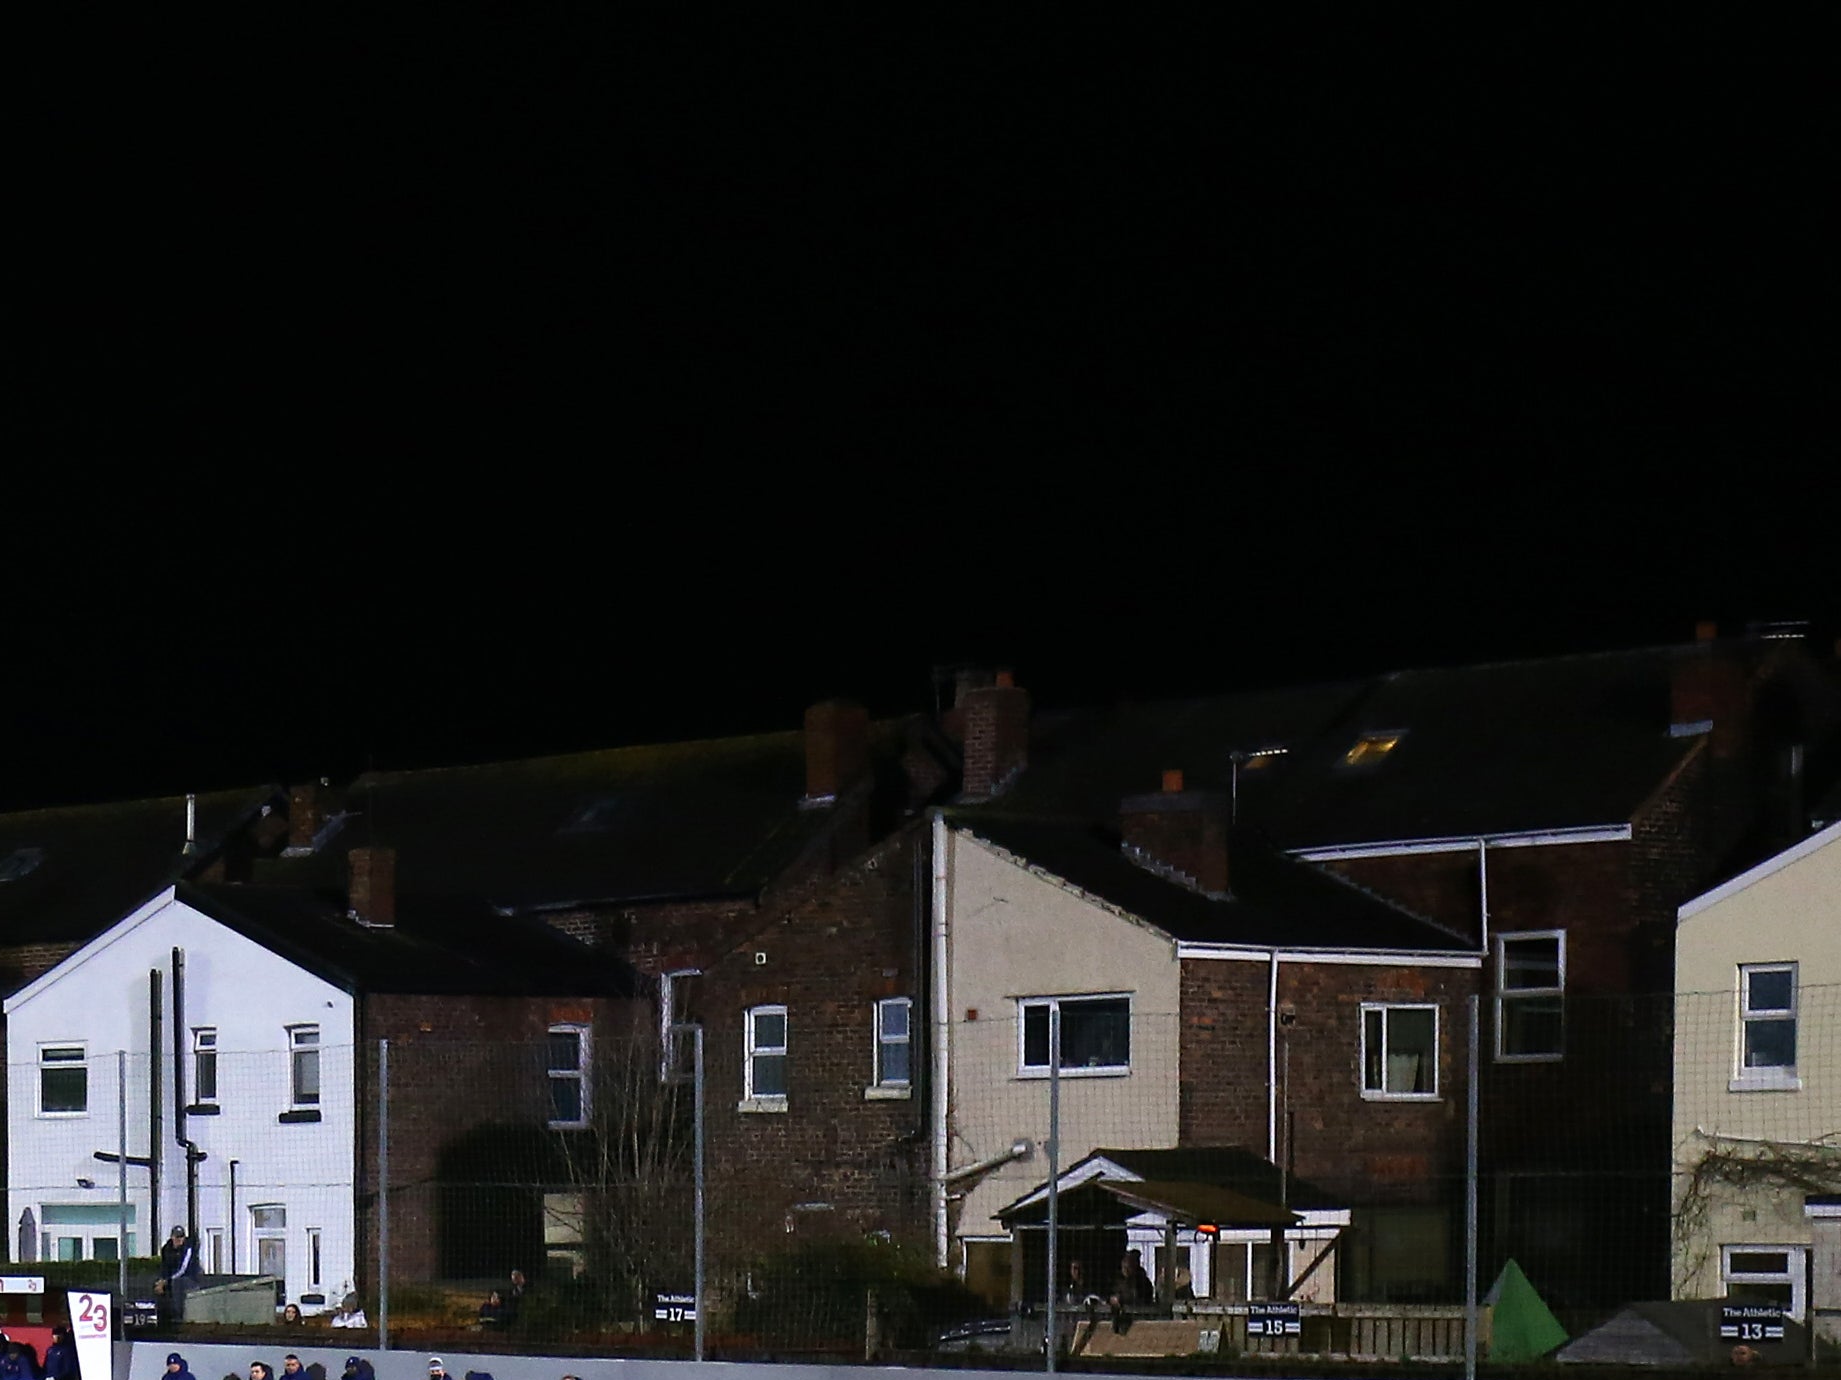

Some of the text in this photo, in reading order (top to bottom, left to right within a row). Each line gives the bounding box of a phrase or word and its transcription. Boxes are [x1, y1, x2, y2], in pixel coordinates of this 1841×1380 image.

[79, 1294, 108, 1332] 23
[669, 1308, 683, 1322] 17
[1266, 1320, 1283, 1335] 15
[1742, 1323, 1763, 1340] 13
